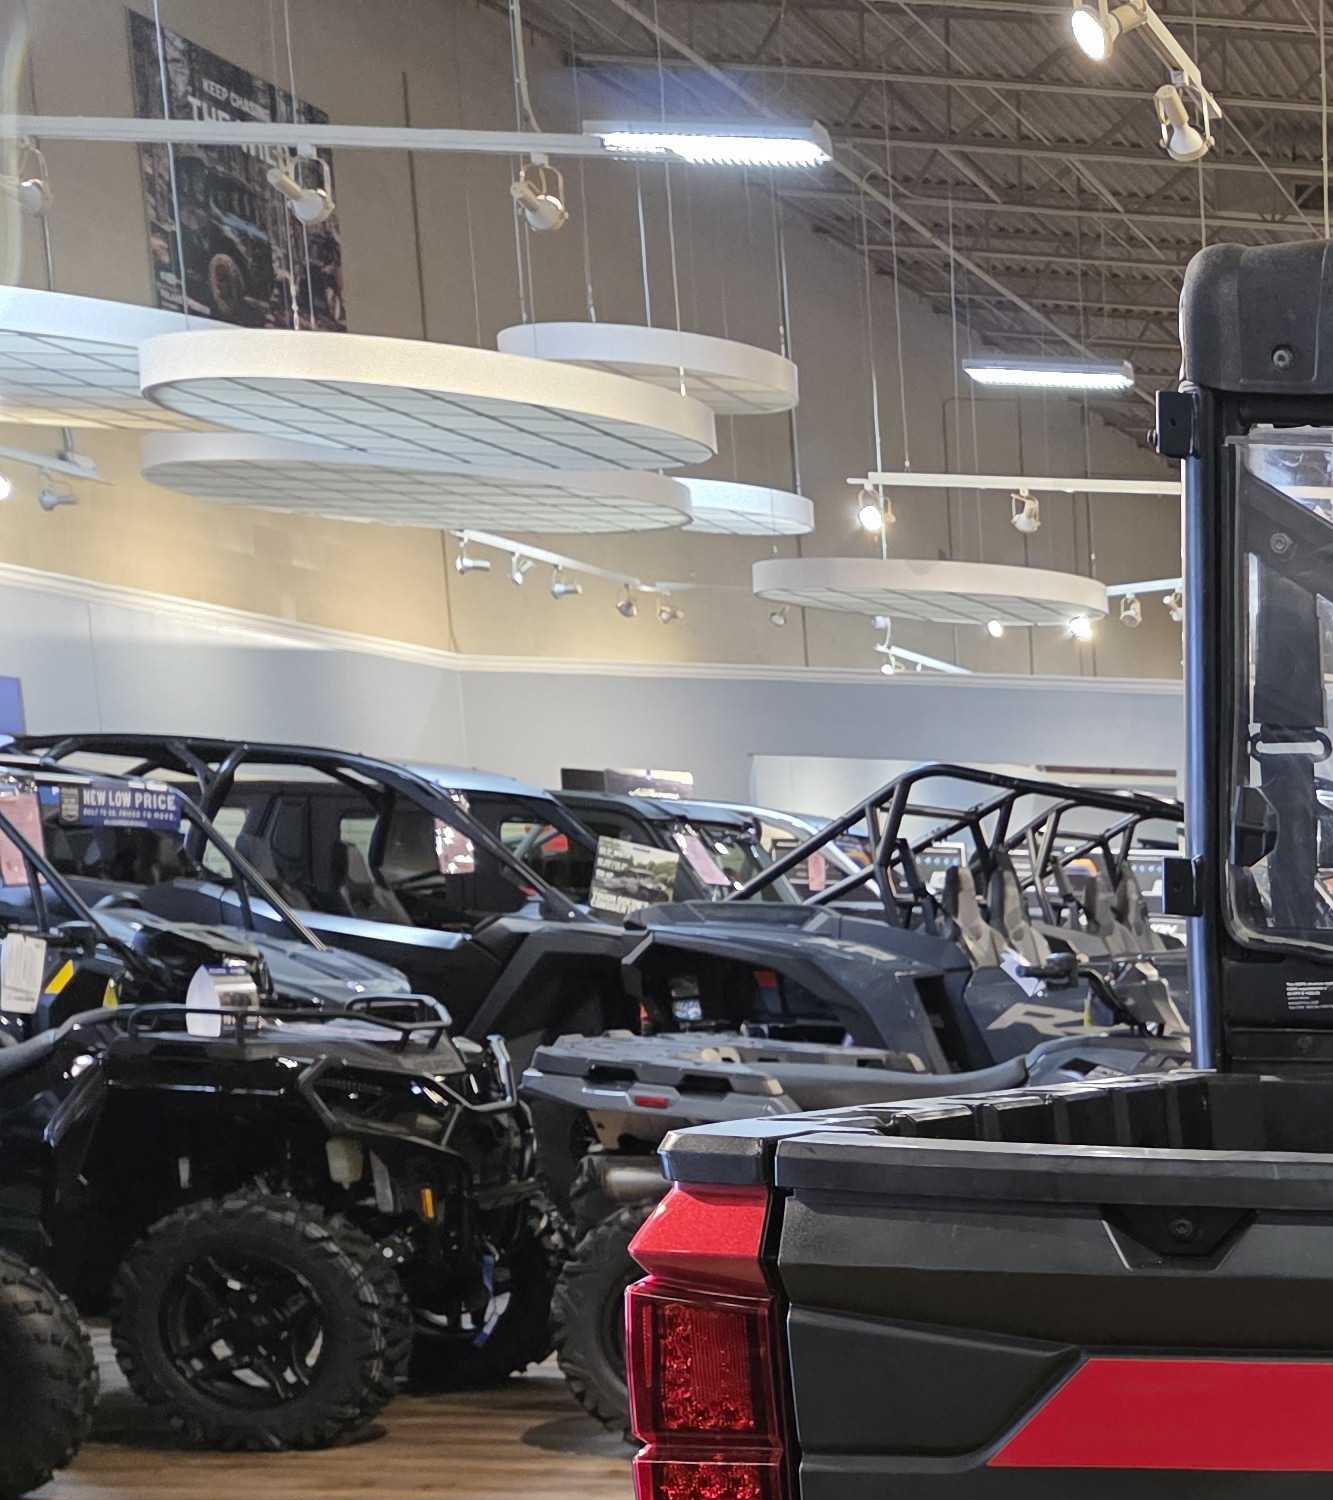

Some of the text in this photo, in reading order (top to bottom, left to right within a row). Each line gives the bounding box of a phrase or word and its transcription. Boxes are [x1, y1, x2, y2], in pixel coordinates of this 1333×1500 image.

[202, 78, 229, 102] KEEP
[83, 789, 106, 806] NEW
[108, 790, 131, 808] LOW
[134, 792, 177, 811] PRICE
